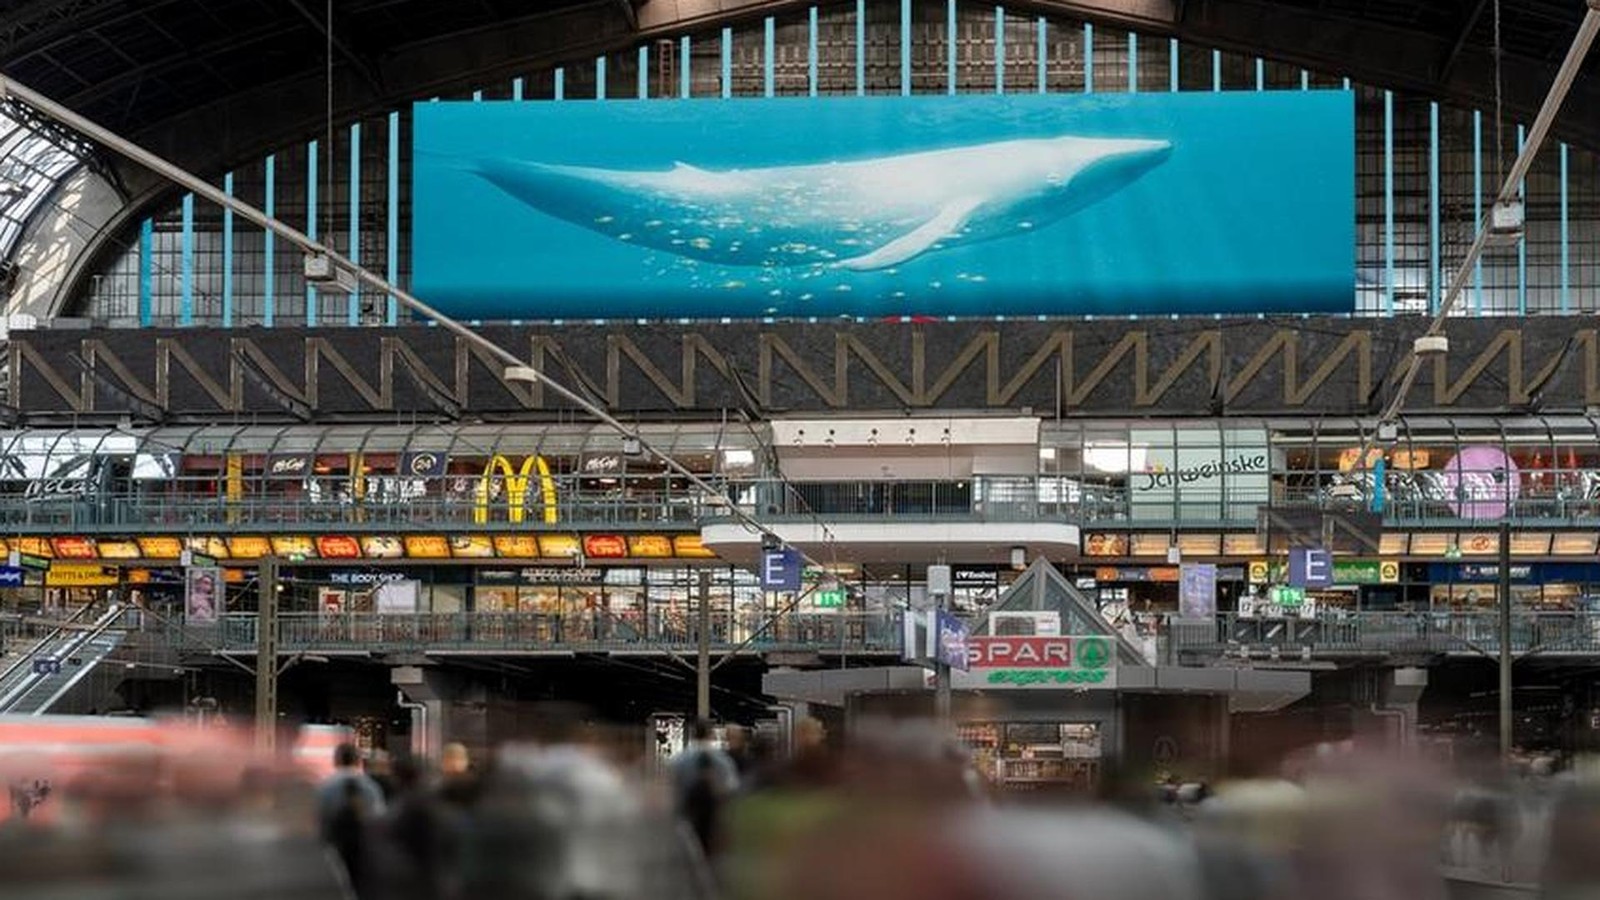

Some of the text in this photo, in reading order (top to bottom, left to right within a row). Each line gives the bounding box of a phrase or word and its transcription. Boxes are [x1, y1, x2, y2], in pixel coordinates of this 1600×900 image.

[765, 554, 785, 584] E
[1305, 550, 1326, 580] E
[331, 573, 404, 583] THE BODY SHOP
[968, 642, 1067, 662] SPAR
[987, 669, 1108, 686] express
